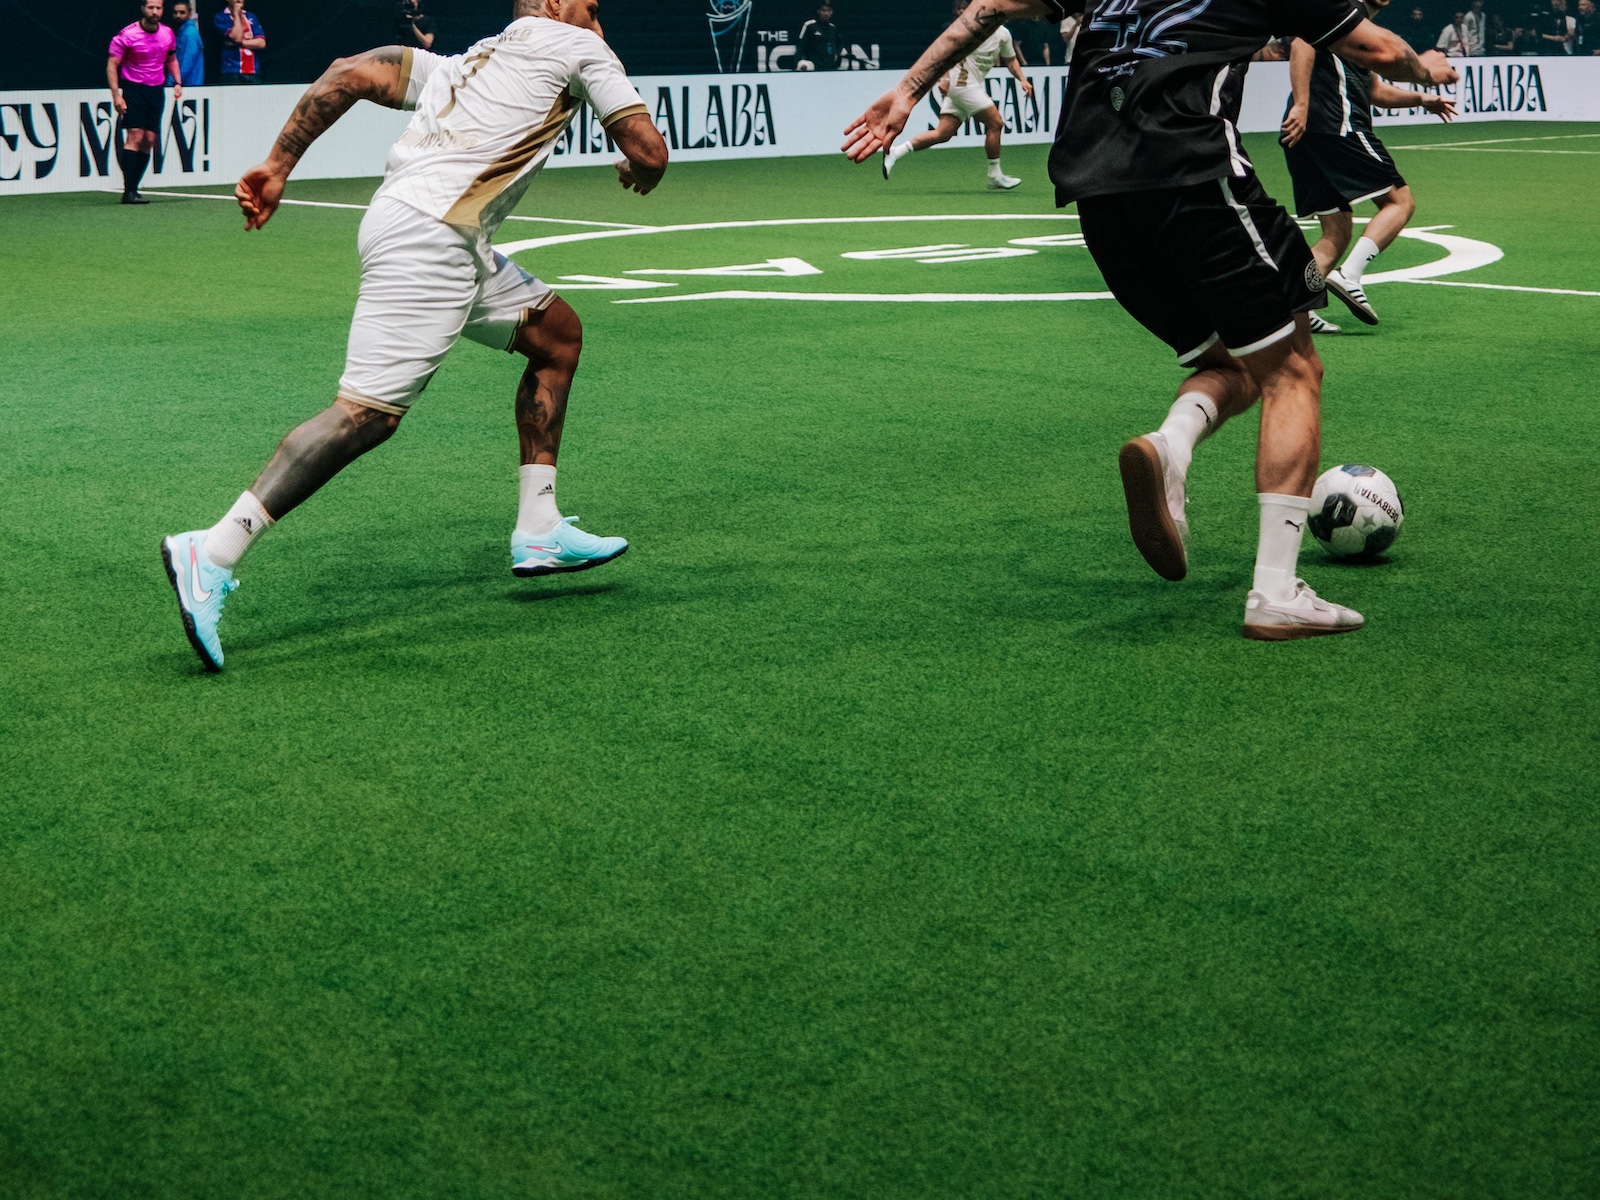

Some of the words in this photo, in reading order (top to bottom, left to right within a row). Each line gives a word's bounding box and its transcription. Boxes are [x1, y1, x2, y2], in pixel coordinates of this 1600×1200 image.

[757, 30, 789, 42] THE
[757, 44, 880, 73] ICN
[1464, 64, 1547, 113] ALABA
[79, 98, 210, 178] NW!
[656, 84, 777, 150] ALABA
